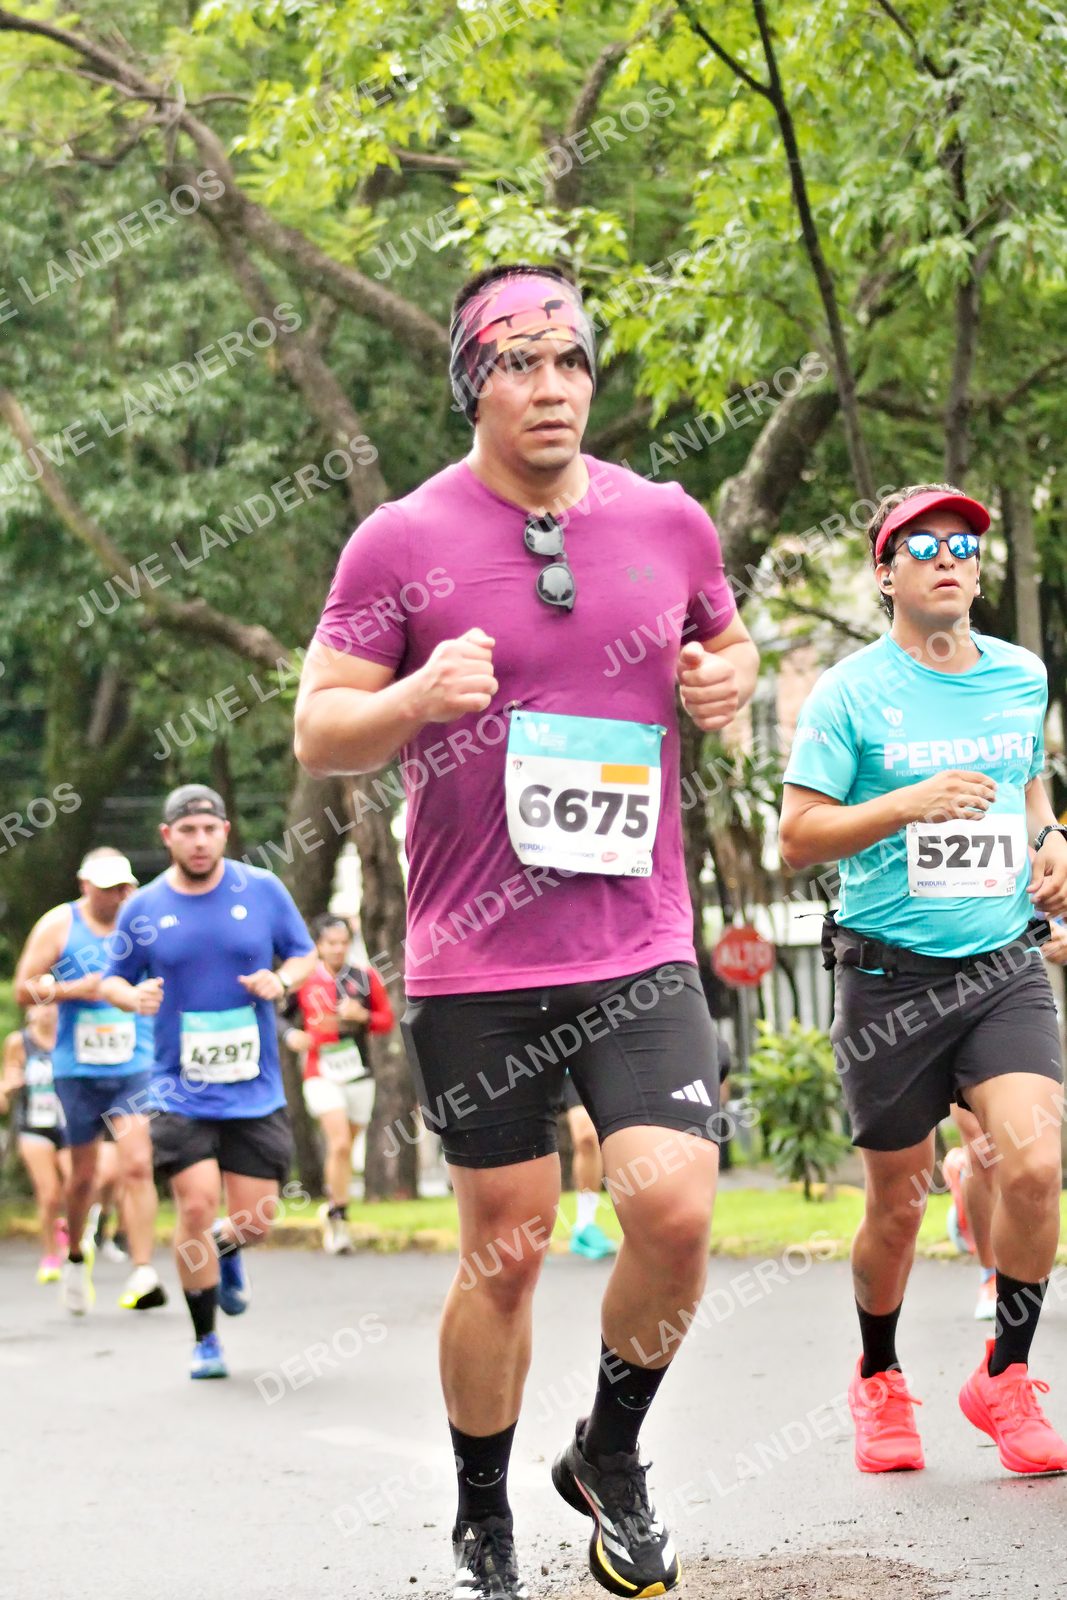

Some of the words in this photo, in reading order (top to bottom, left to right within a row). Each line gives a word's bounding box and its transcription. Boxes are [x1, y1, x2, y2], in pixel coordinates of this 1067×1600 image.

[519, 784, 649, 838] 6675
[519, 843, 546, 851] PERDU
[917, 834, 1013, 869] 5271
[719, 941, 773, 968] ALTO
[191, 1042, 253, 1065] 4297
